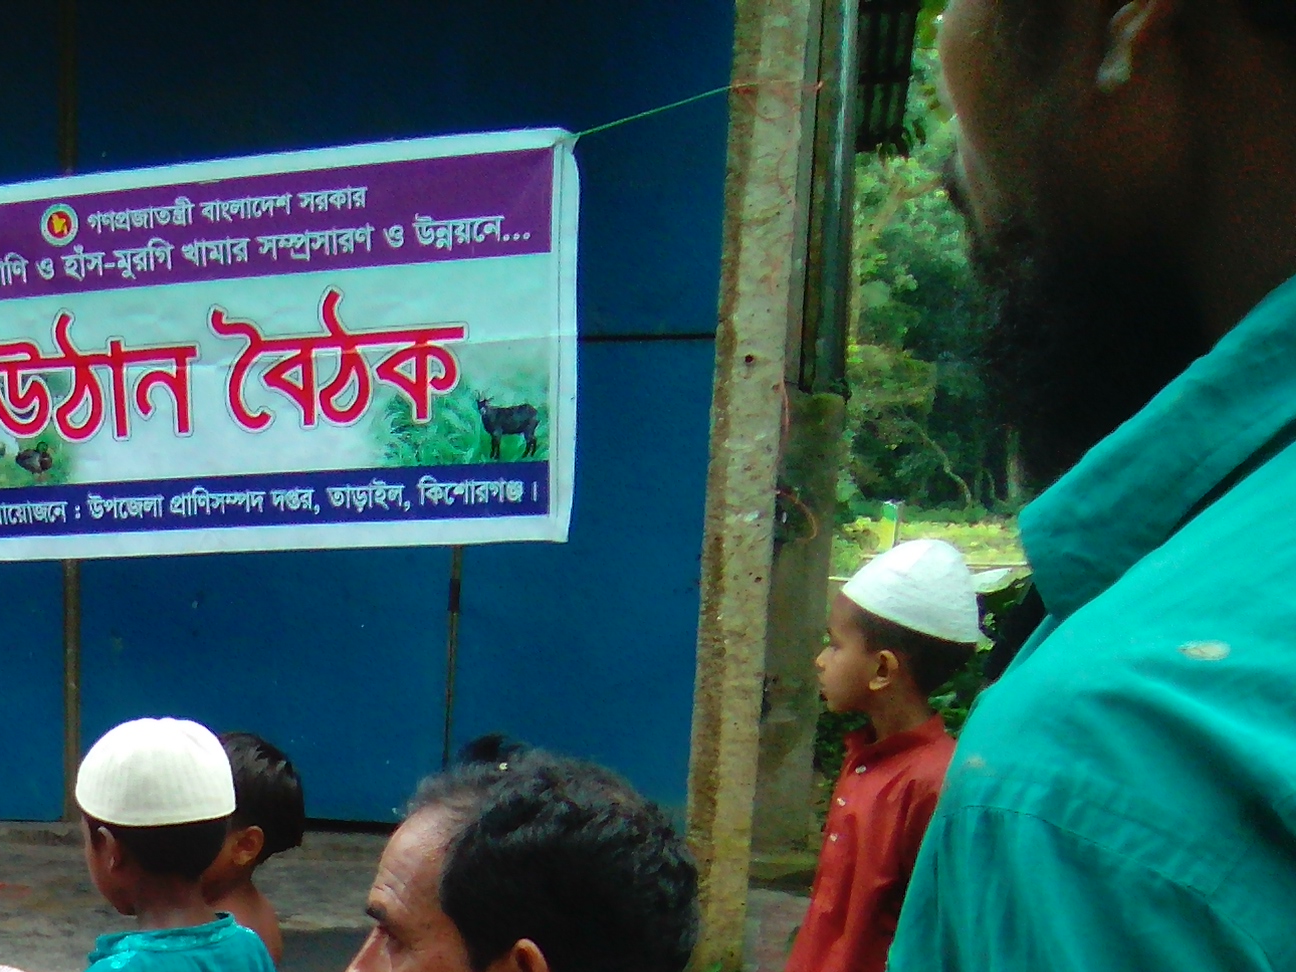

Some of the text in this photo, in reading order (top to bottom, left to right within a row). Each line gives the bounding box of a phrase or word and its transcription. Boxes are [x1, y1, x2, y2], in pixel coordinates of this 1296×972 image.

[87, 185, 368, 234] গণপ্রজাতন্ত্রী বাংলাদেশ সরকার
[36, 257, 55, 281] ও
[60, 238, 175, 281] হাঁস-মুরগি
[182, 237, 251, 267] খামার
[256, 222, 375, 262] সম্প্রসারণ
[384, 224, 405, 249] ও
[209, 287, 467, 432] বৈঠক
[87, 492, 164, 521] উপজেলা
[169, 485, 266, 518] প্রাণিসম্পদ
[270, 486, 321, 515] দপ্তর,
[326, 477, 411, 513] তাড়াইল,
[416, 474, 524, 507] কিশোরগঞ্জ
